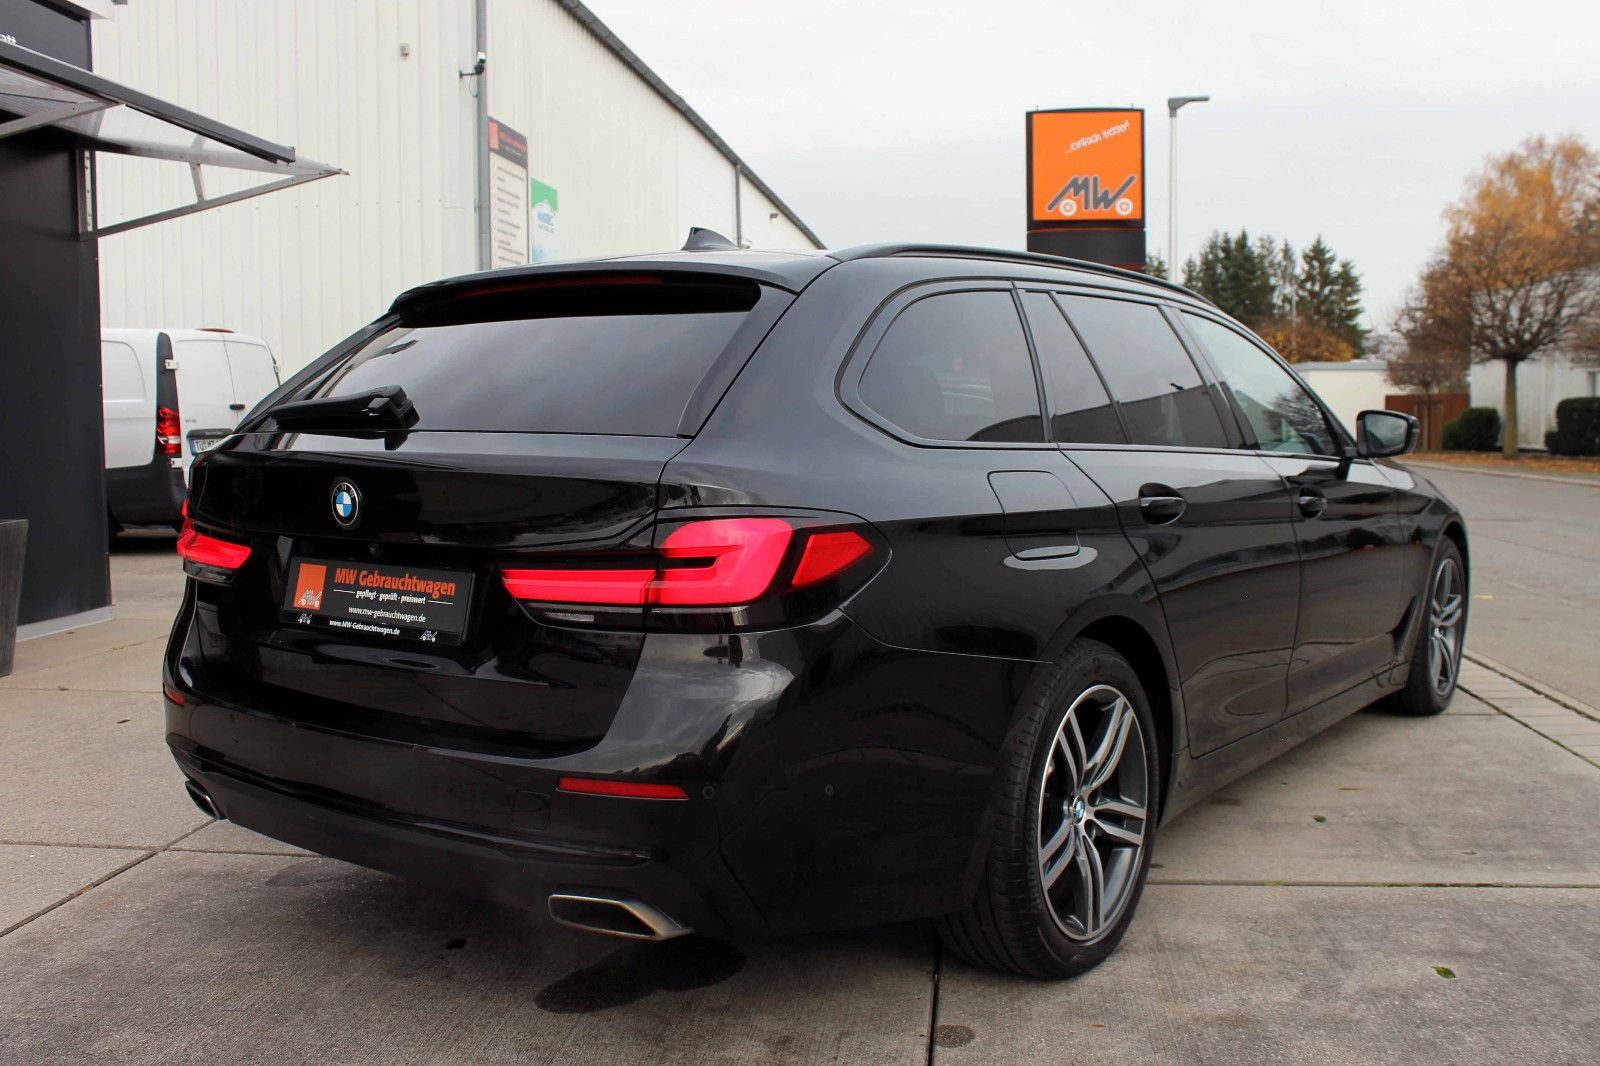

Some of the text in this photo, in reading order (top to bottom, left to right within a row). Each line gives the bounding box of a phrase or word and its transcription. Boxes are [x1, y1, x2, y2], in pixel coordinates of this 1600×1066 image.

[1047, 175, 1136, 212] MW
[335, 568, 456, 599] MW Gebrauchtwagen
[355, 588, 426, 605] gepflegt geprüft preiswert
[348, 606, 426, 623] www.mw-gebrauchtwagen.de
[329, 619, 400, 635] www.MW-Gebrauchtwagen.de
